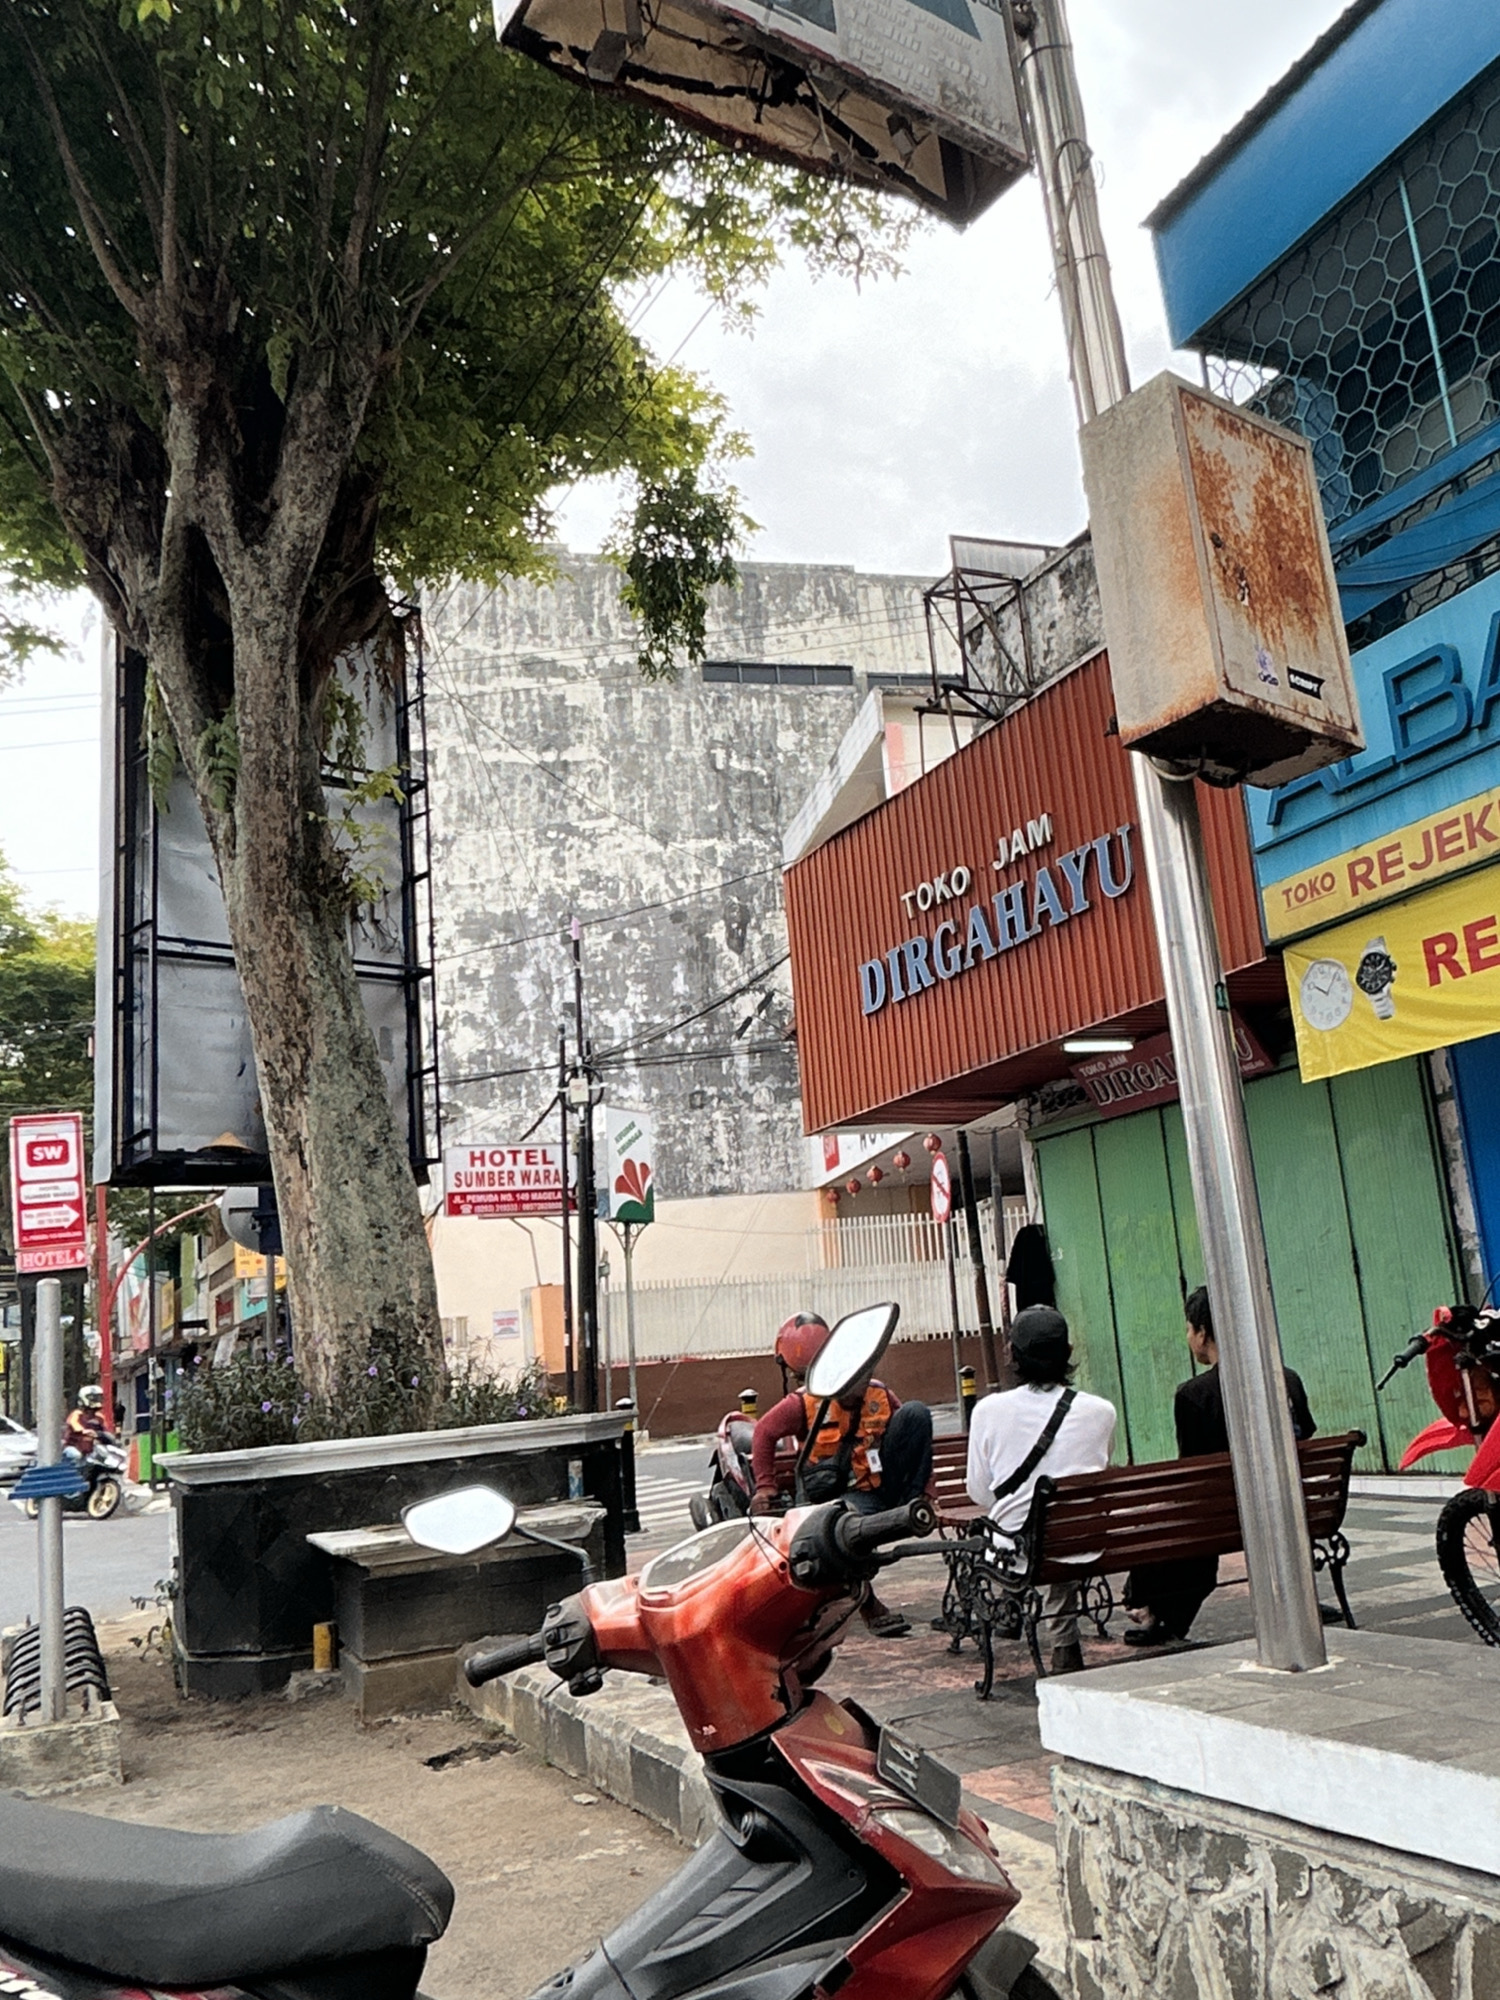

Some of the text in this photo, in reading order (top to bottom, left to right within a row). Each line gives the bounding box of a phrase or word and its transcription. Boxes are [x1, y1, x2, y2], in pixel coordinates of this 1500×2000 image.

[1281, 798, 1500, 909] TOKO REJEK
[900, 812, 1053, 920] TOKO JAM
[858, 822, 1133, 1016] DIRGAHAYU
[1079, 1054, 1129, 1078] TOKO JAM
[32, 1145, 64, 1162] SW
[469, 1149, 555, 1167] HOTEL
[454, 1169, 563, 1188] SUMBER WARA
[531, 1190, 573, 1200] MAGELA
[22, 1249, 75, 1268] HOTEL
